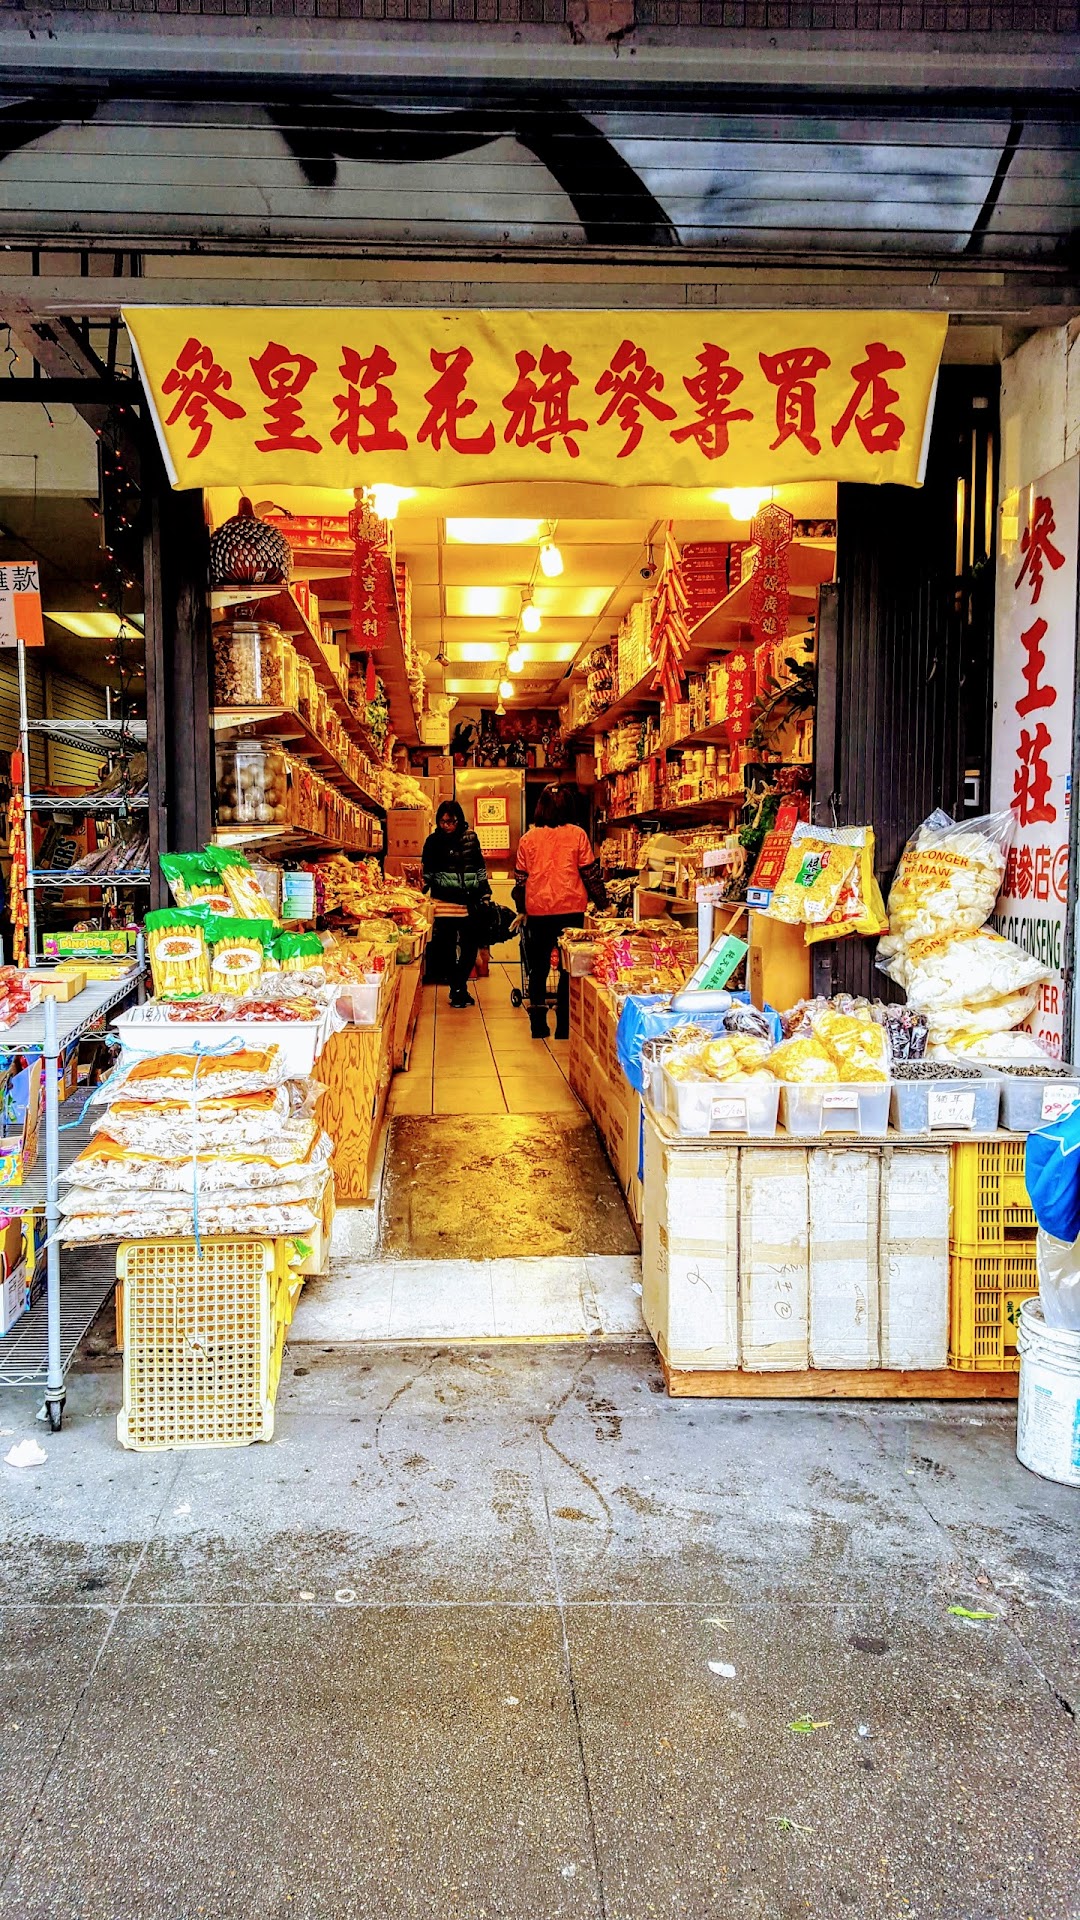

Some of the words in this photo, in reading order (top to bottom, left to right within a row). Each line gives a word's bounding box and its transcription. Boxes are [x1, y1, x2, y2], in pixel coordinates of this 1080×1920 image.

[361, 552, 378, 637] 大吉大利
[917, 863, 951, 877] MAW
[921, 850, 969, 867] CONGER
[1020, 917, 1061, 970] GINSENG
